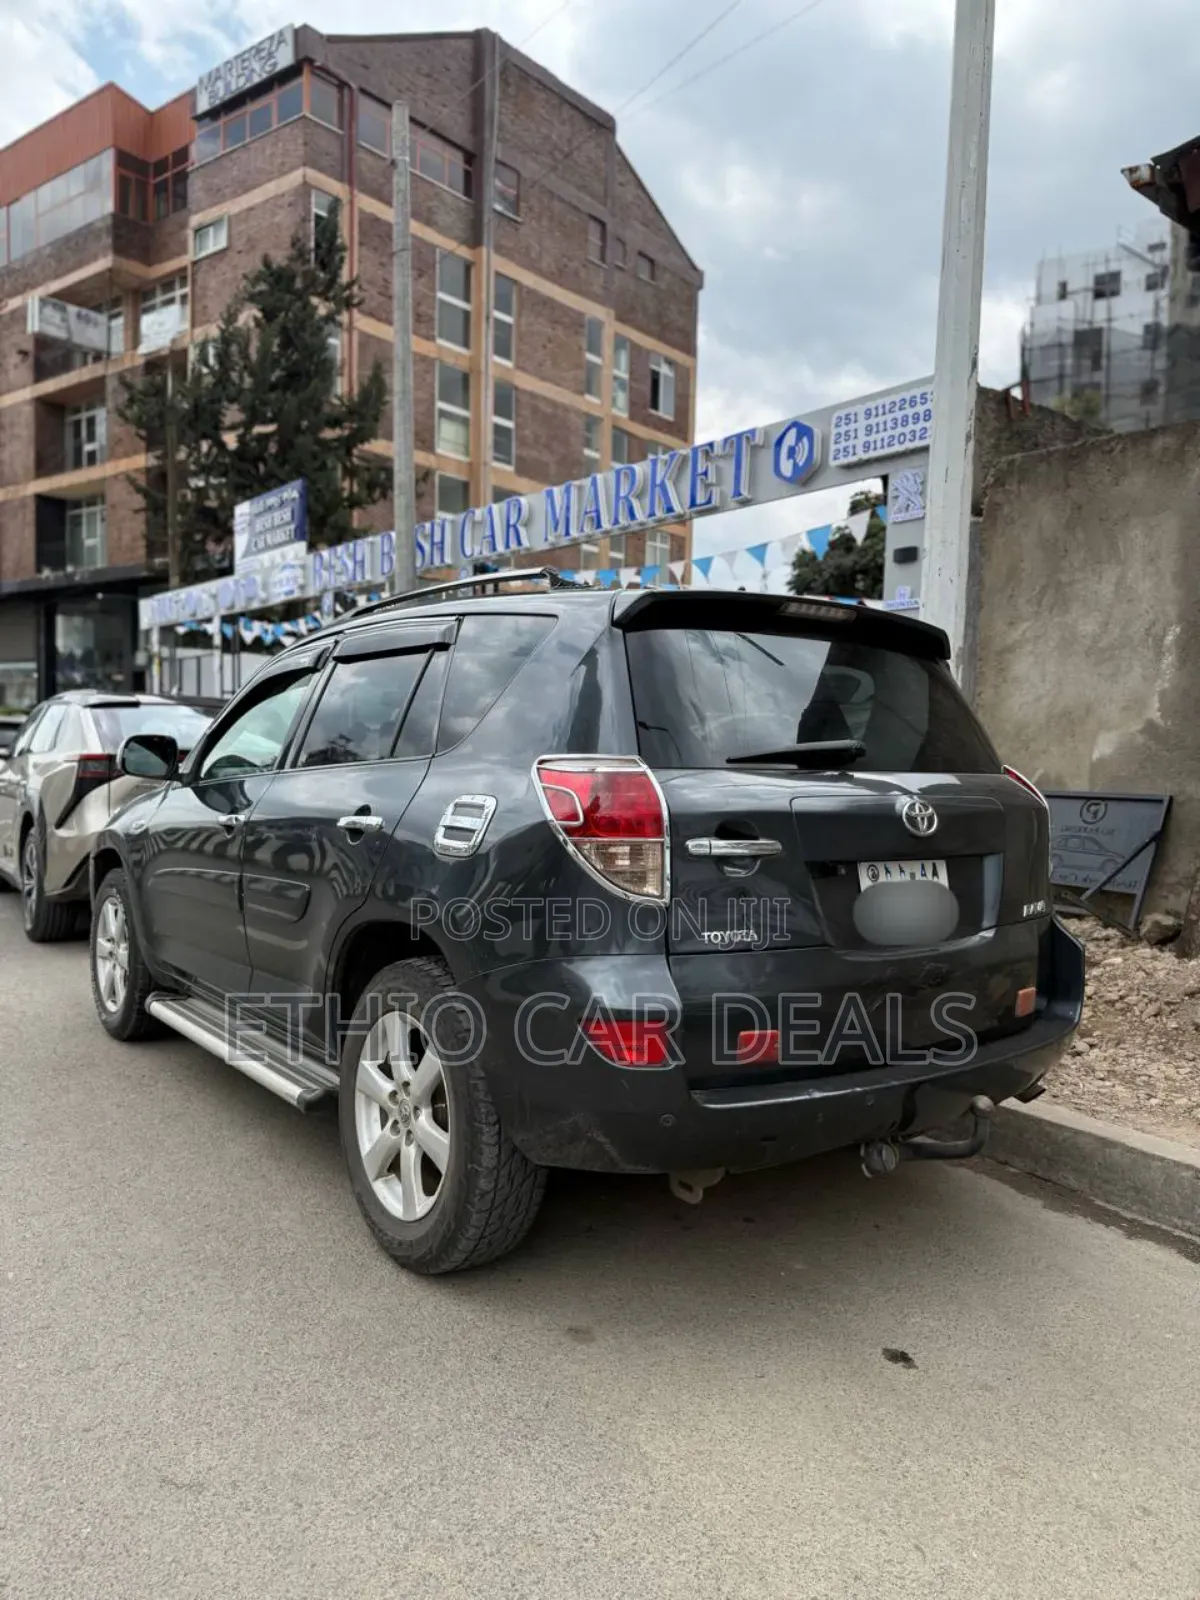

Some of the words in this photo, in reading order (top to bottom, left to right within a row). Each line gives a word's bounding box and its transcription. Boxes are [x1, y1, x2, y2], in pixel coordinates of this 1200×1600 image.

[835, 411, 858, 428] 251
[864, 391, 934, 420] 9112265
[832, 444, 857, 461] 251
[862, 426, 932, 454] 9112032
[834, 428, 858, 445] 251
[381, 519, 447, 577] BSH
[460, 497, 525, 560] CAR
[544, 428, 759, 542] MARKET
[701, 929, 759, 944] TOYOTA
